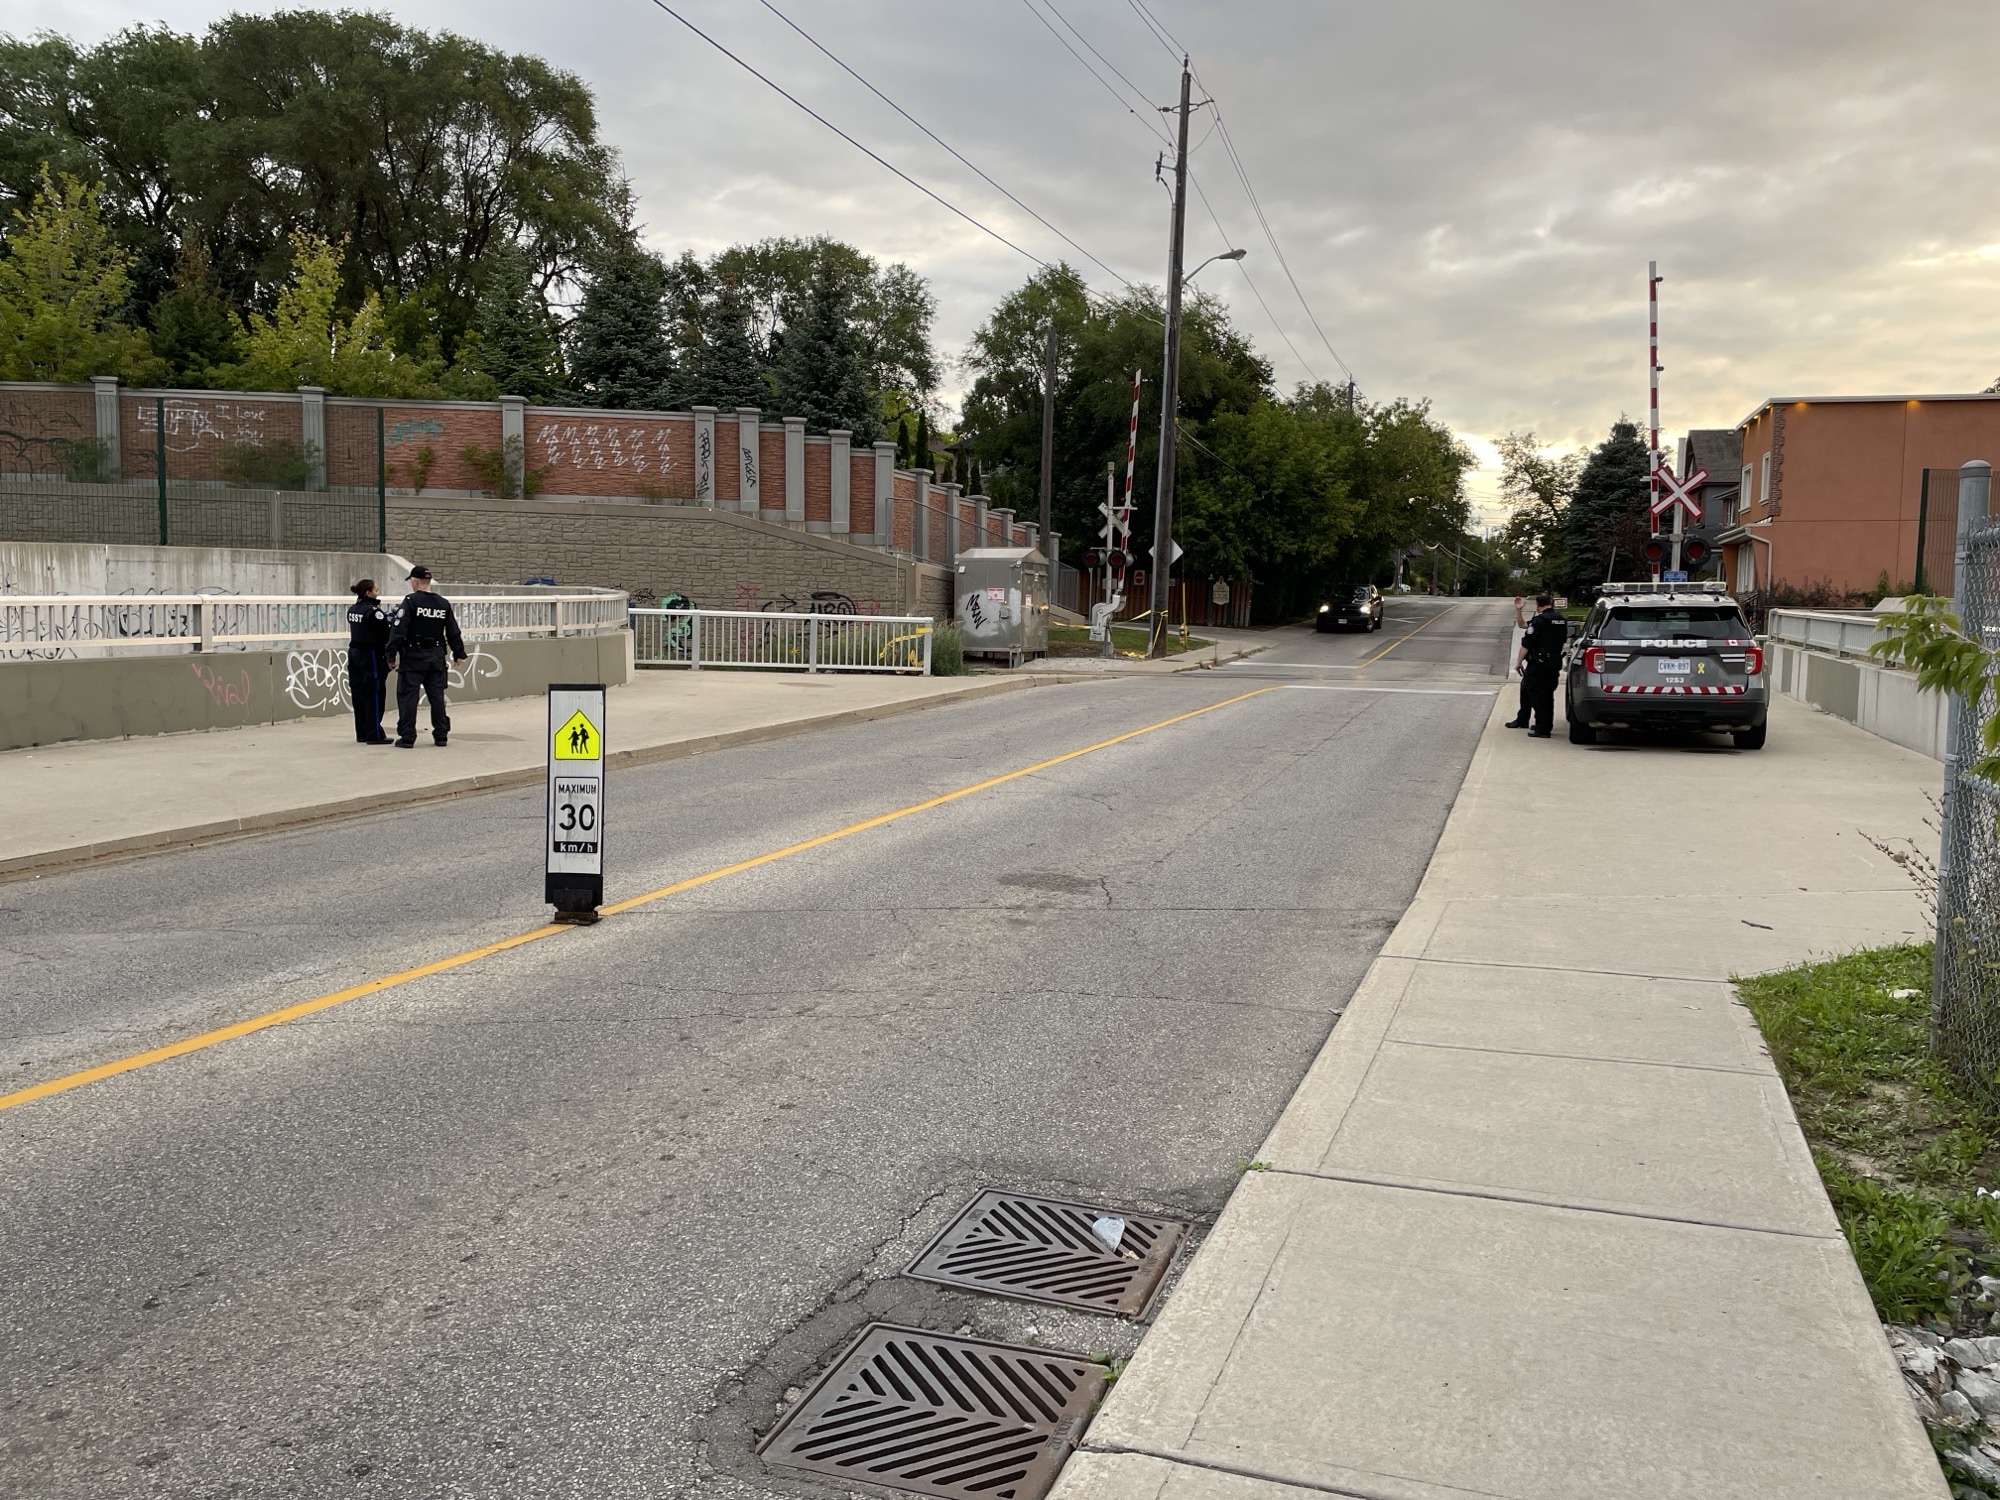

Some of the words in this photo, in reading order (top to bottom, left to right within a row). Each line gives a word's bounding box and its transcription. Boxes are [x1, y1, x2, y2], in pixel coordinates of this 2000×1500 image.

[216, 405, 230, 419] I
[236, 406, 265, 421] Love
[348, 613, 364, 623] CSST
[416, 607, 446, 619] POLICE
[1640, 639, 1708, 648] POLICE
[558, 784, 597, 795] MAXIMUM
[559, 804, 595, 831] 30
[560, 843, 593, 853] km/h
